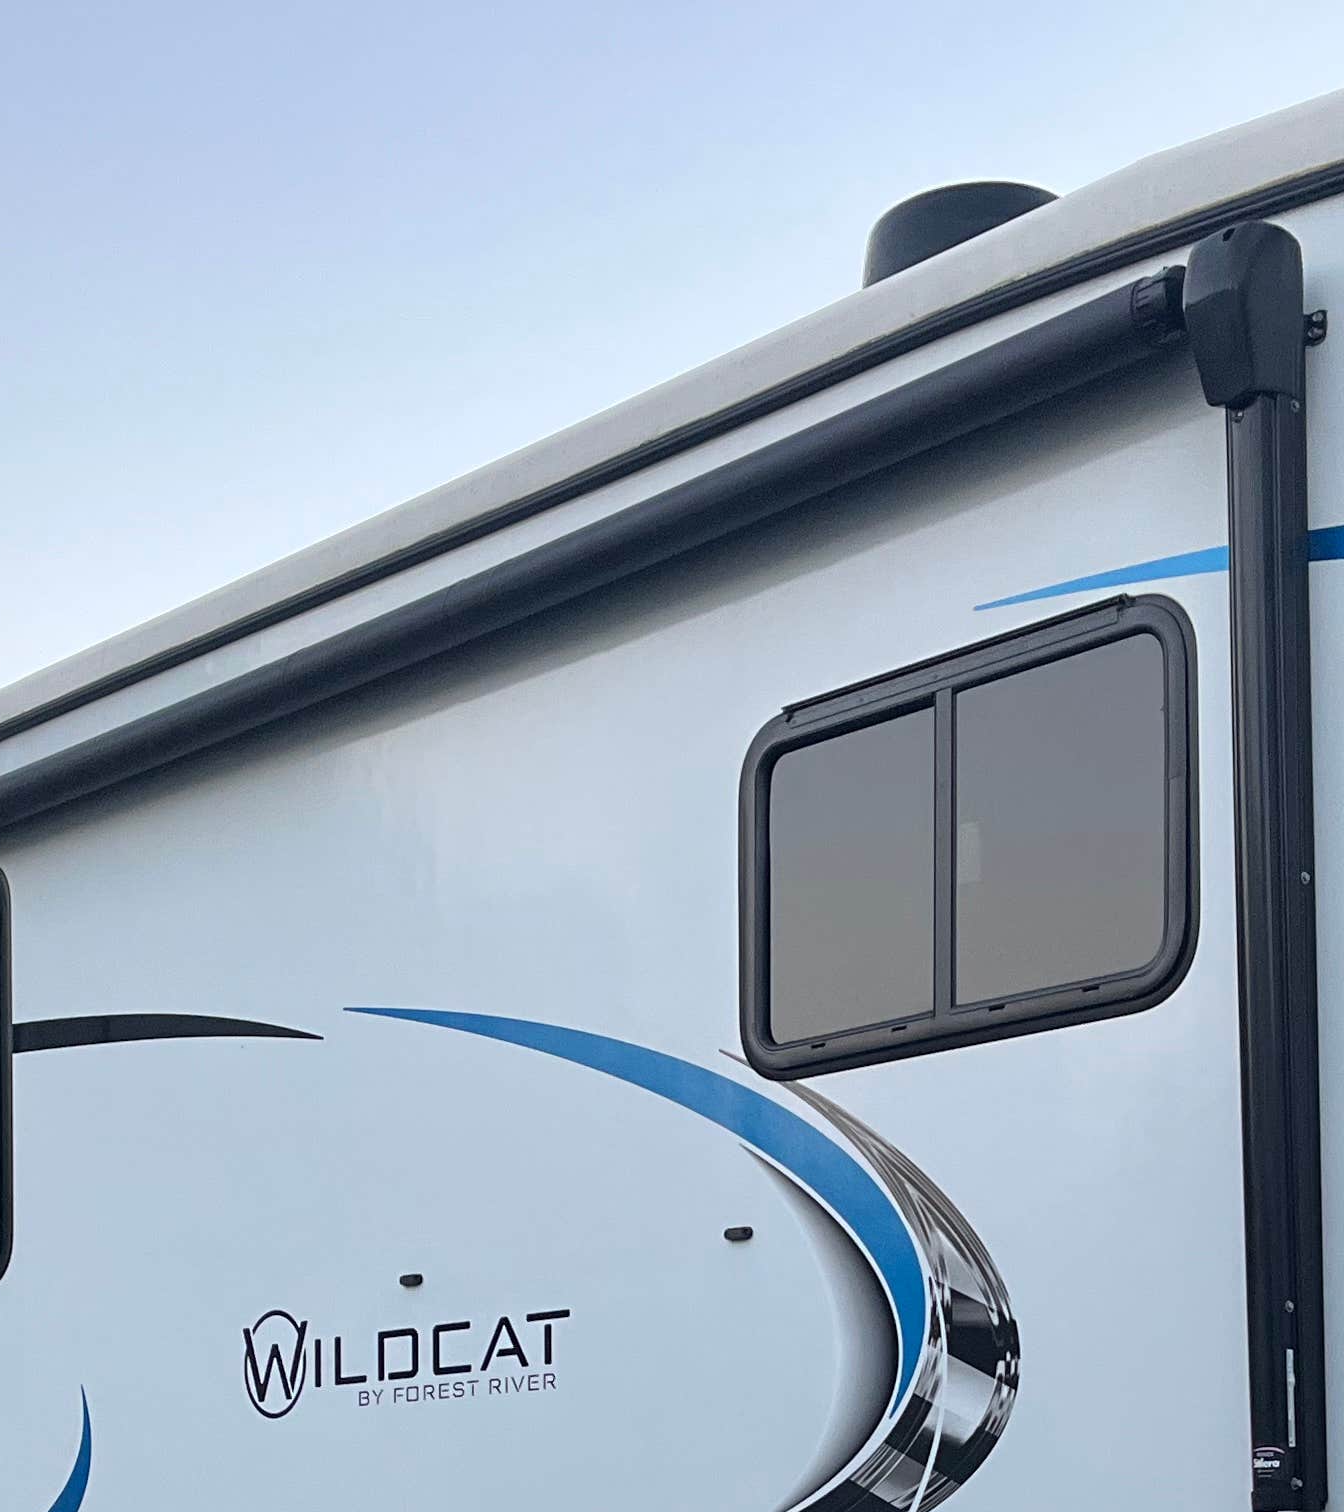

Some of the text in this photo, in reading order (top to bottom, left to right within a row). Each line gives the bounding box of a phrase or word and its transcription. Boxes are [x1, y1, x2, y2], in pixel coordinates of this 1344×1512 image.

[242, 1309, 571, 1406] WILDCAT
[358, 1373, 557, 1407] BY FOREST RIVER
